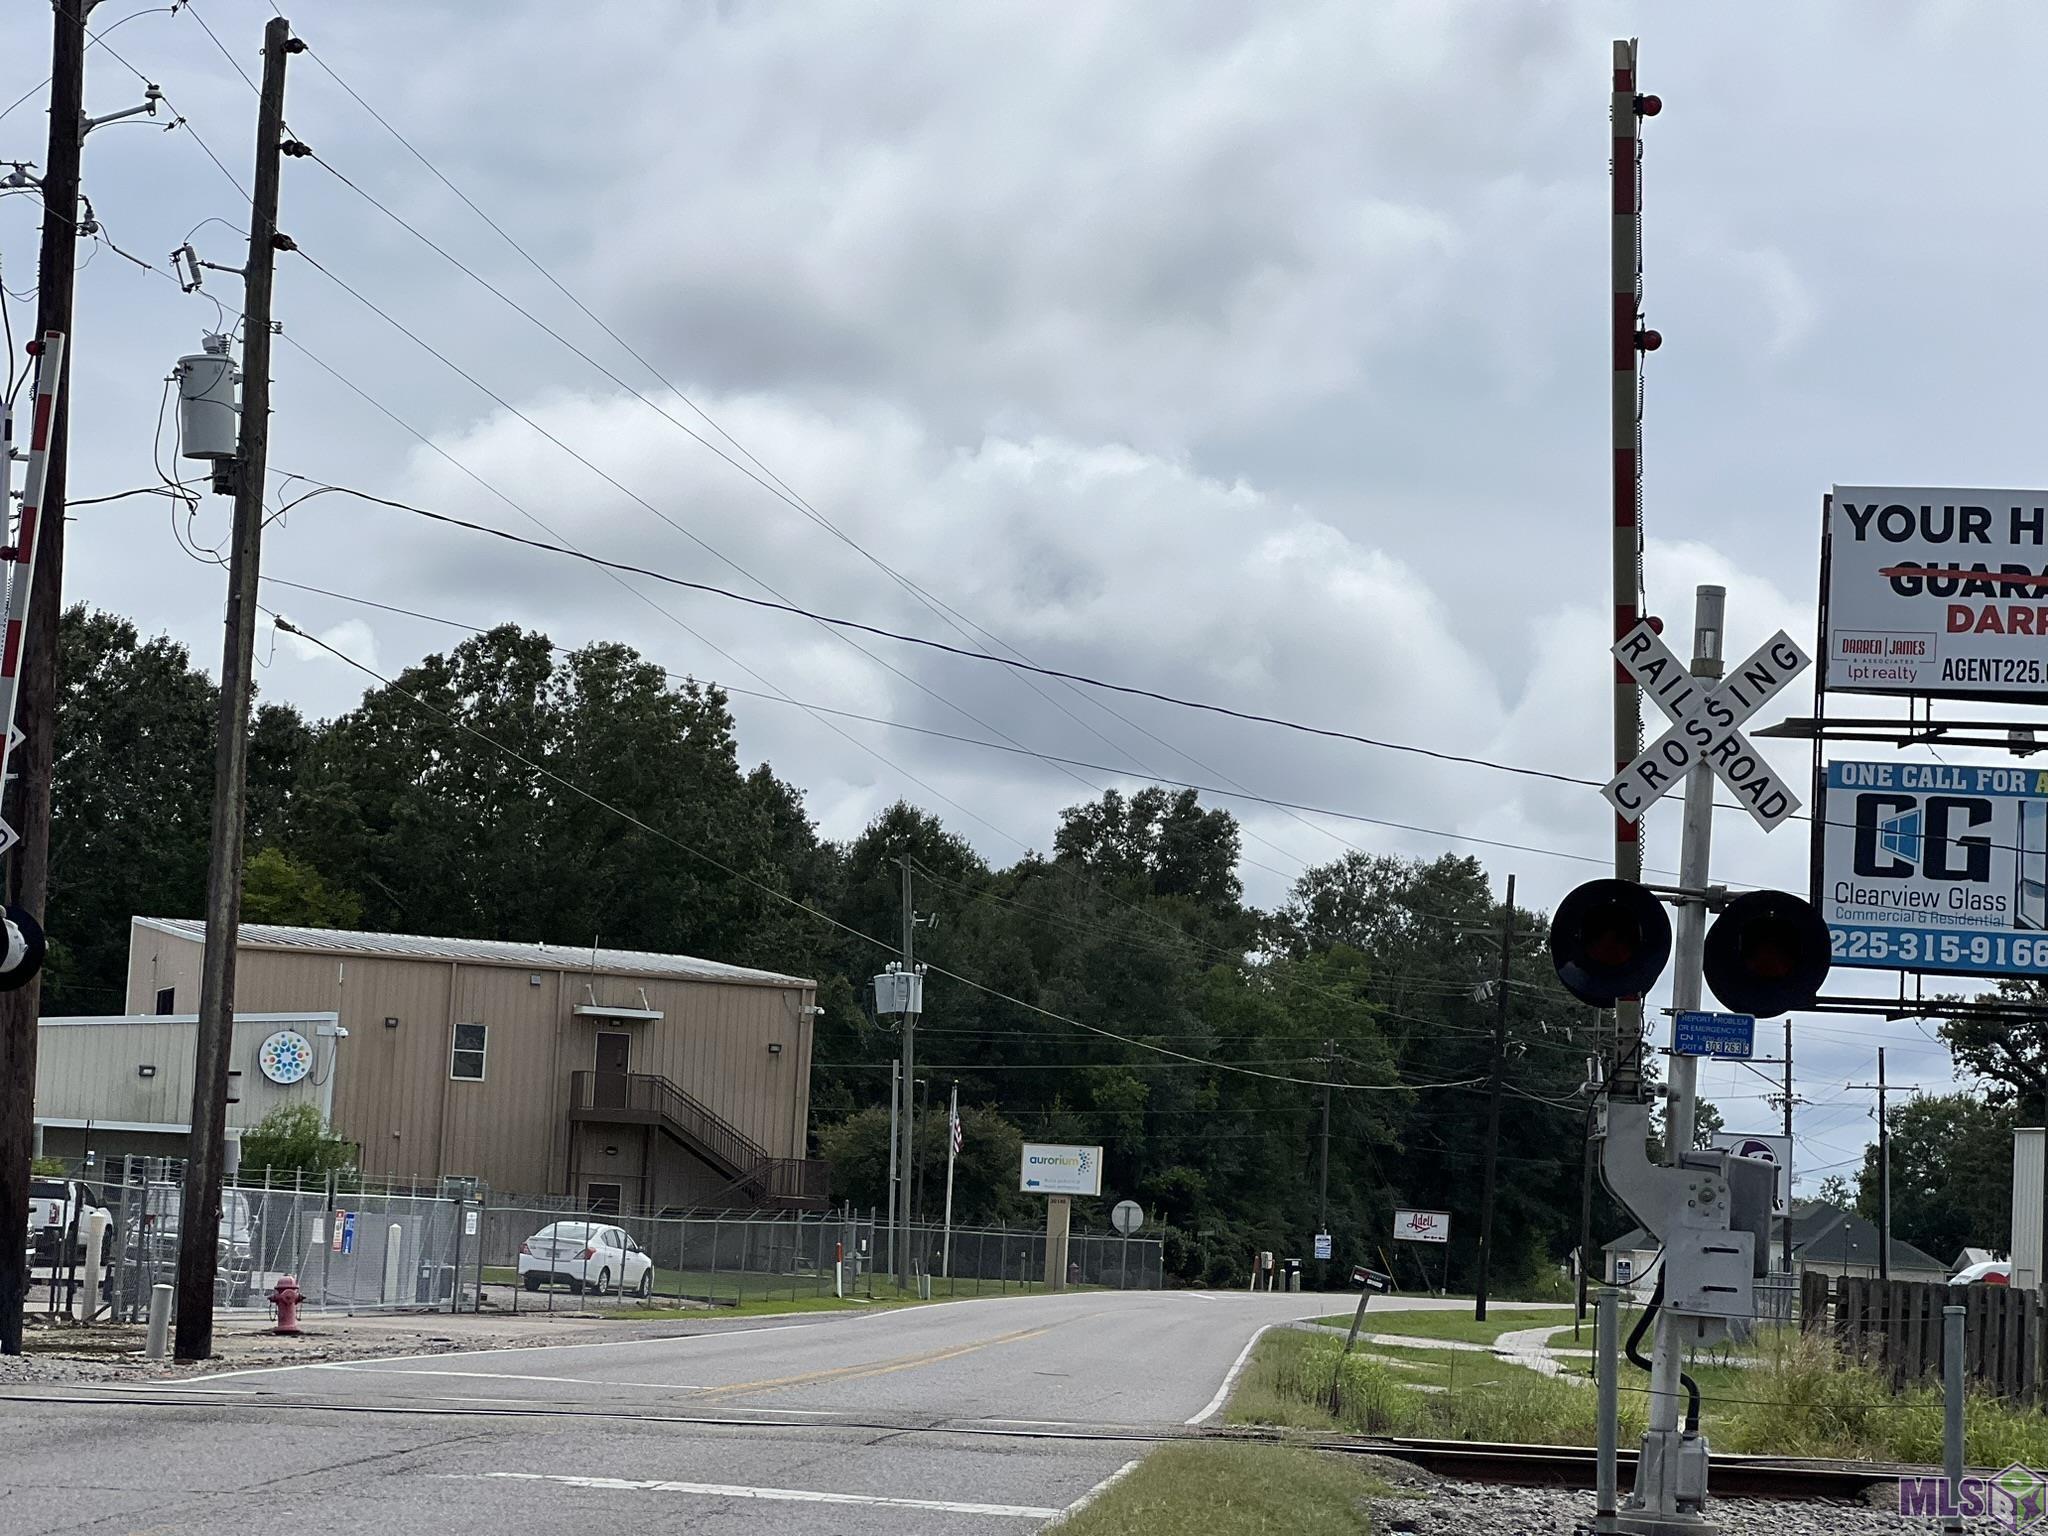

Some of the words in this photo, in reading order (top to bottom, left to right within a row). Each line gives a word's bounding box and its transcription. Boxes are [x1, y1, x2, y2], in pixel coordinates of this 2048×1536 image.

[1843, 503, 1992, 544] YOUR
[2010, 507, 2044, 545] H
[1842, 638, 1882, 654] DARREN
[1889, 640, 1925, 656] JAMES
[1848, 665, 1869, 682] lpt
[1873, 666, 1918, 683] realty
[1942, 657, 2048, 684] AGENT225.
[1614, 643, 1798, 810] CROSSING
[1621, 631, 1693, 718] RAIL
[1709, 735, 1788, 819] ROAD
[1841, 763, 1892, 787] ONE
[1902, 766, 1967, 790] CALL
[1976, 769, 2026, 793] FOR
[1835, 881, 1940, 908] Clearview
[1949, 887, 2007, 912] Glass
[1835, 906, 1914, 923] Commercial
[1918, 911, 1926, 924] &
[1930, 911, 2005, 928] Residential
[1831, 929, 2048, 967] 225-315-9166
[1029, 1154, 1079, 1165] aurorium
[1407, 1213, 1438, 1231] Adell
